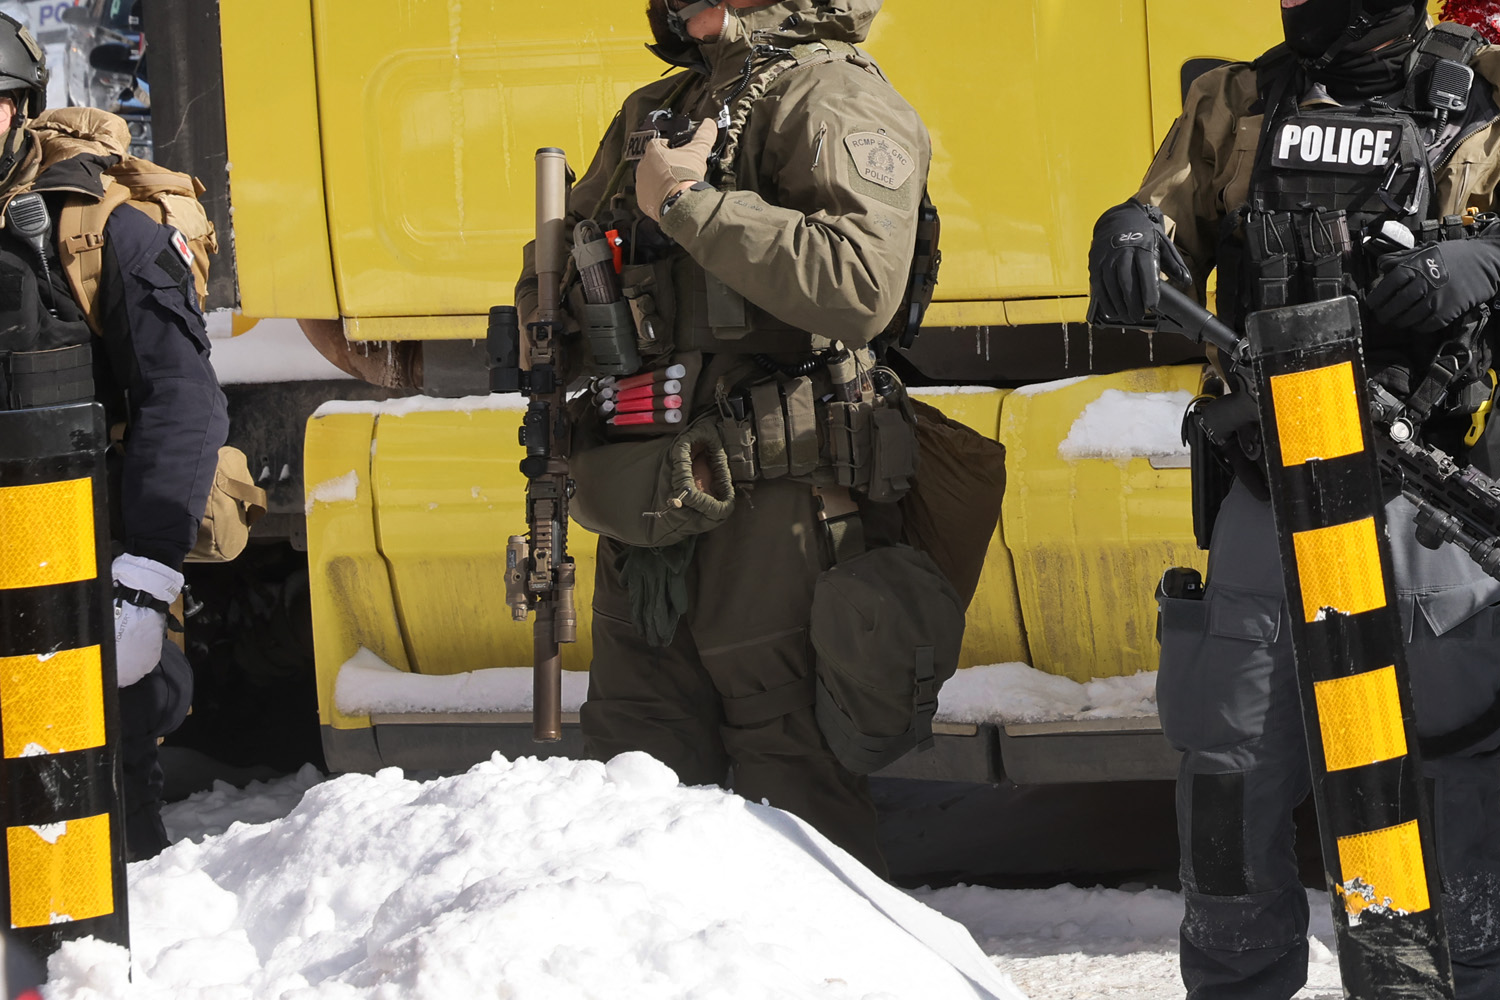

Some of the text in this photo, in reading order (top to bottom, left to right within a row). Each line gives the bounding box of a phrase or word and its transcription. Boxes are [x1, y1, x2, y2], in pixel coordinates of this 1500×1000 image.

[626, 135, 653, 157] POLI
[852, 138, 907, 166] RCMP GRC
[1278, 123, 1392, 167] POLICE
[865, 168, 894, 186] POLICE
[1426, 258, 1440, 279] OR
